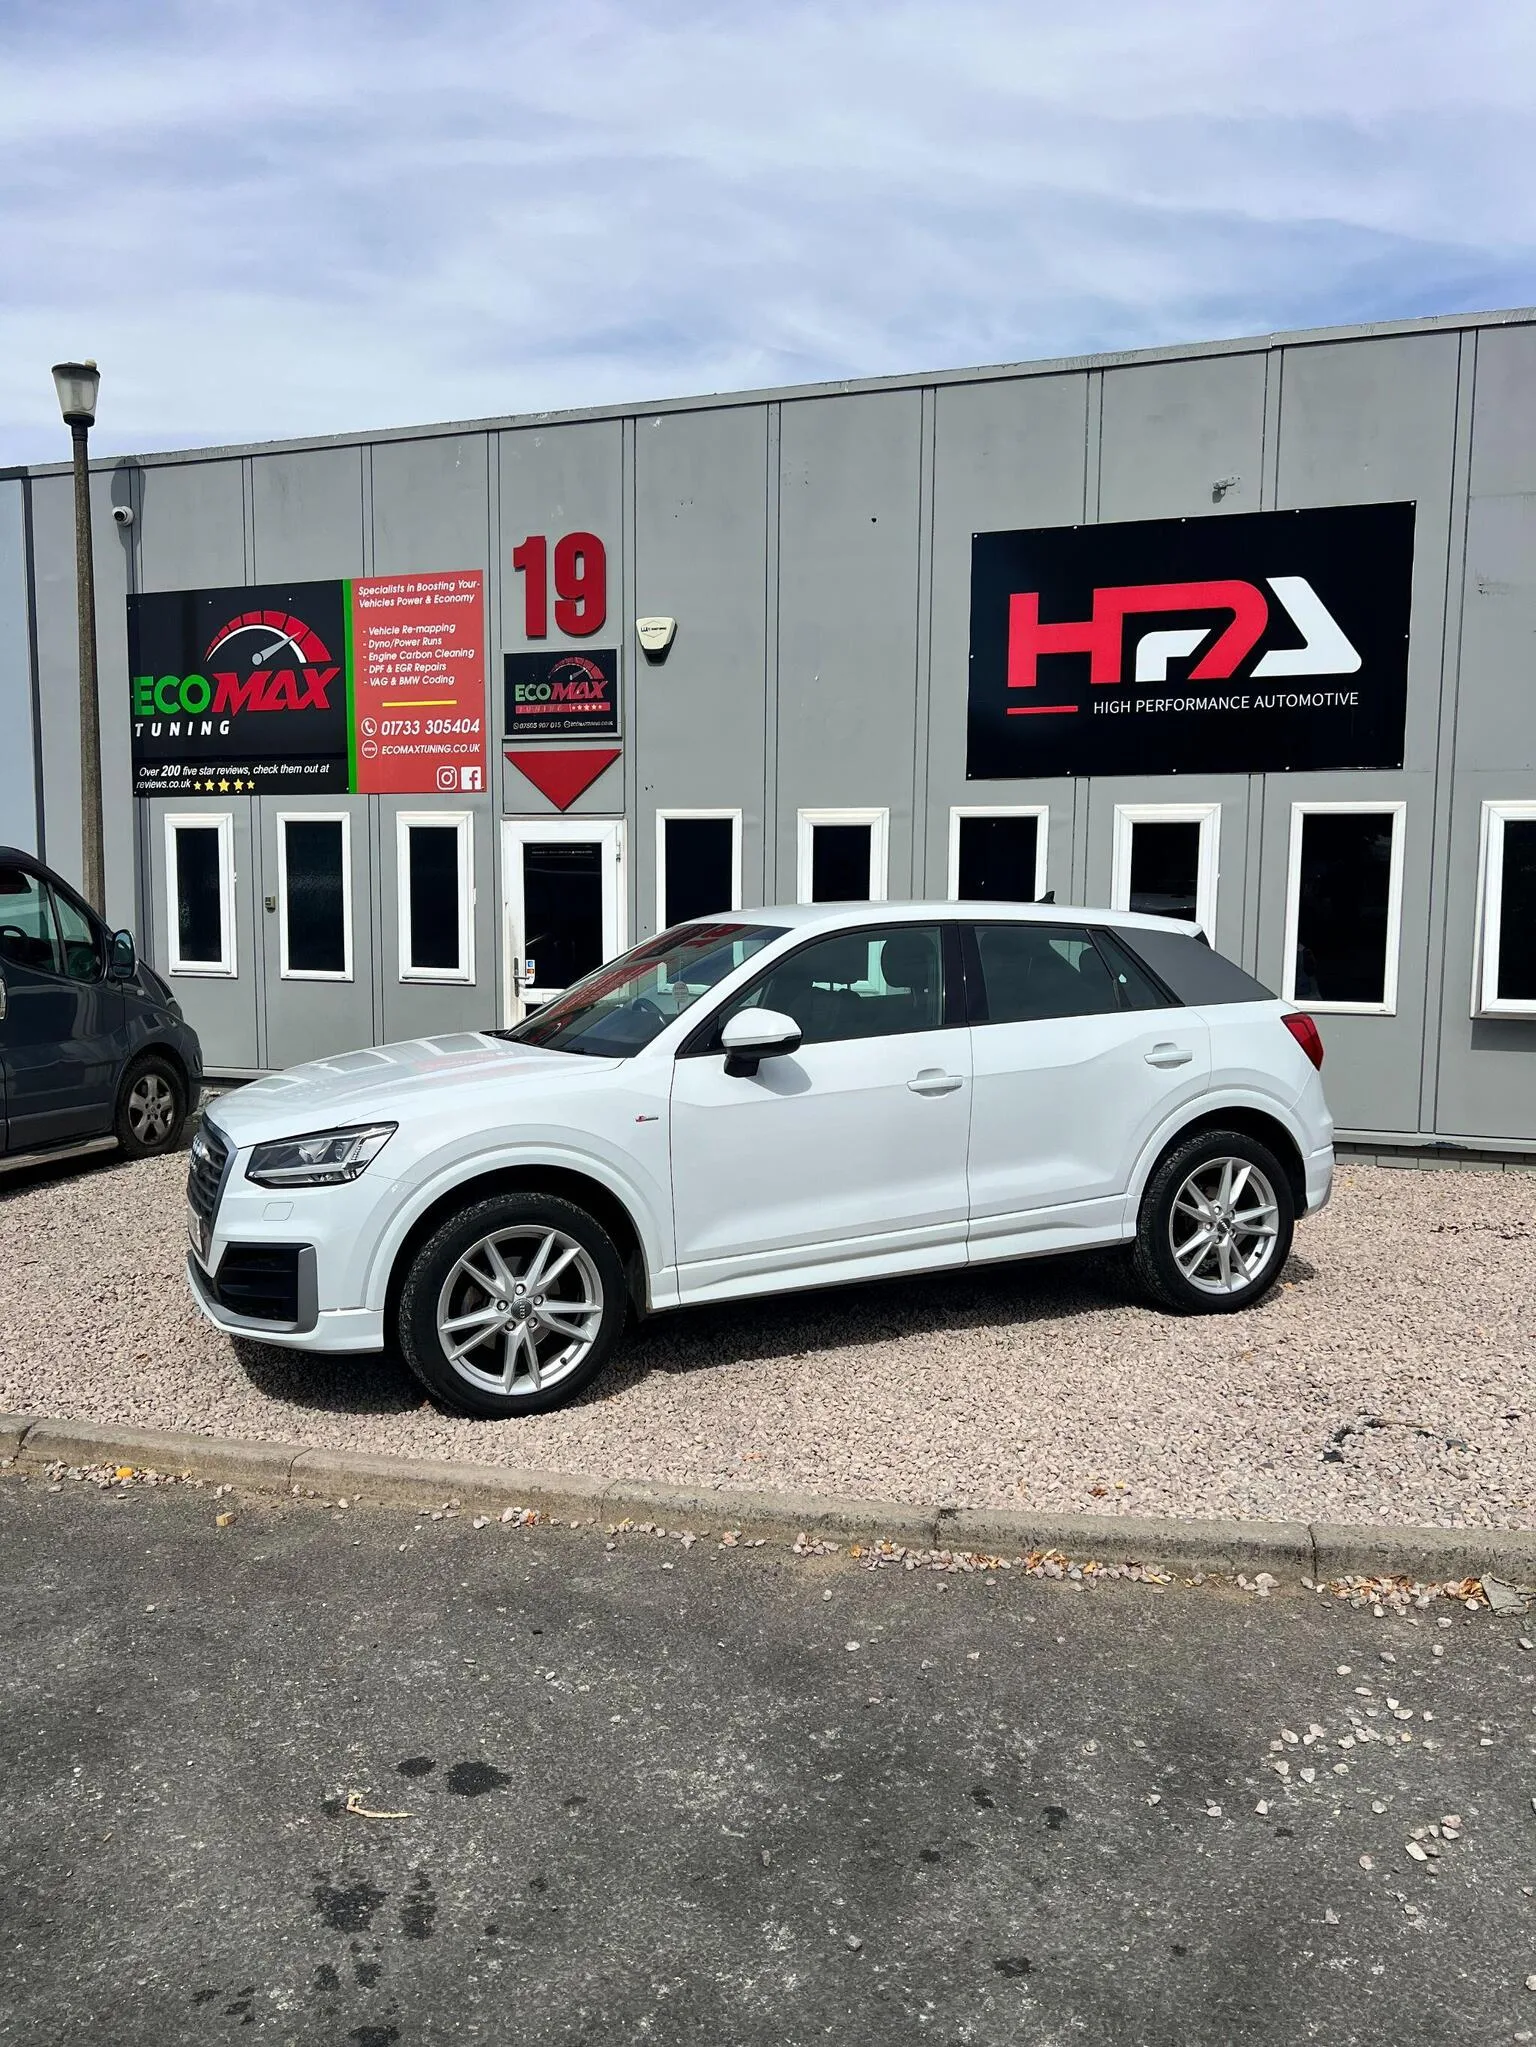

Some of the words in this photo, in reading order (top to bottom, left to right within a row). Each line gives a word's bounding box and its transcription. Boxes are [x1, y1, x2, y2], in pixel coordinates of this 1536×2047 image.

[358, 583, 405, 597] Specialists
[407, 582, 415, 592] in
[416, 581, 456, 592] Boosting
[512, 531, 606, 637] 19
[359, 598, 395, 608] Vehicles
[397, 596, 423, 606] Power
[425, 595, 431, 604] &
[434, 594, 475, 604] Economy
[368, 626, 400, 636] Vehicle
[402, 623, 456, 634] Re-mapping
[368, 638, 420, 650] Dyno/Power
[422, 636, 442, 646] Runs
[368, 652, 397, 662] Engine
[399, 650, 433, 660] Carbon
[434, 648, 475, 659] Cleaning
[369, 665, 385, 674] DPF
[386, 664, 392, 673] &
[395, 663, 413, 673] EGR
[414, 662, 447, 672] Repairs
[370, 677, 388, 687] VAG
[390, 677, 396, 686] &
[399, 676, 420, 686] BMW
[422, 675, 455, 685] Coding
[133, 667, 341, 717] ECOMAX
[515, 680, 608, 702] ECOMAX
[1093, 699, 1131, 715] HIGH
[1135, 695, 1250, 713] PERFORMANCE
[1254, 691, 1359, 709] AUTOMOTIVE
[135, 720, 230, 738] TUNING
[381, 720, 420, 736] 01733
[425, 718, 480, 735] 305404
[381, 743, 480, 755] ECOMAXTUNING.CO.UK
[139, 766, 159, 777] Over
[160, 764, 181, 777] 200
[182, 765, 197, 776] five
[199, 766, 216, 775] star
[216, 765, 251, 776] reviews,
[253, 764, 279, 774] check
[280, 764, 303, 774] them
[304, 764, 318, 773] out
[319, 763, 330, 773] at
[136, 778, 192, 789] reviews.co.uk
